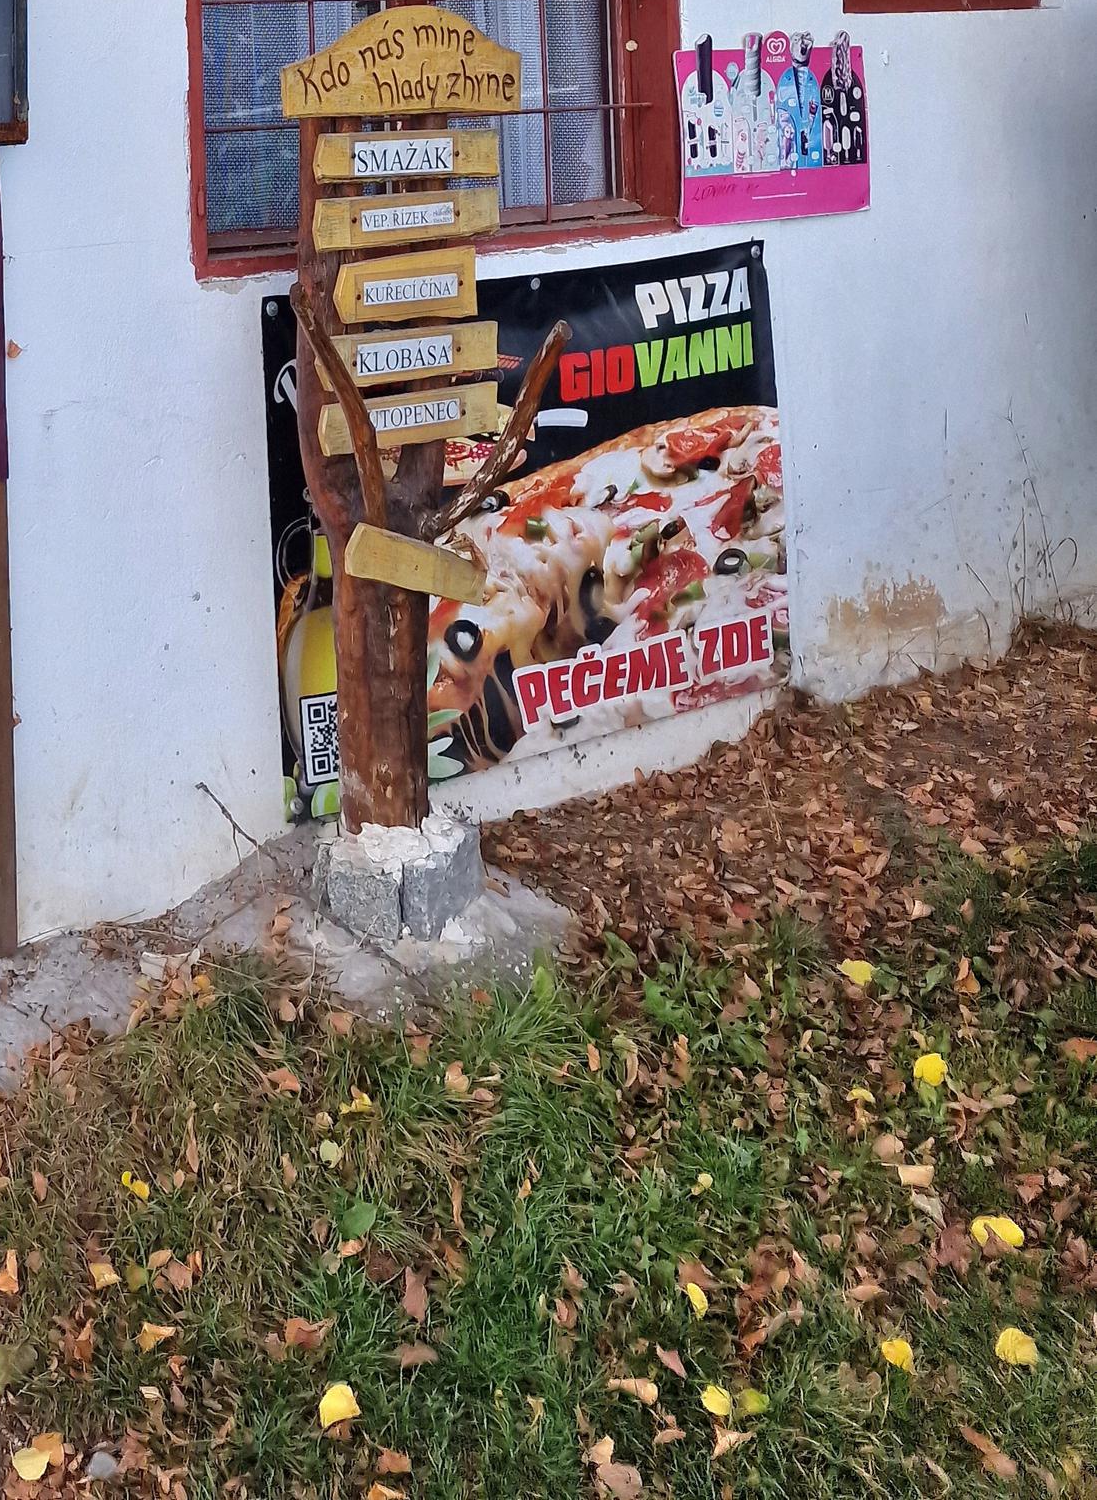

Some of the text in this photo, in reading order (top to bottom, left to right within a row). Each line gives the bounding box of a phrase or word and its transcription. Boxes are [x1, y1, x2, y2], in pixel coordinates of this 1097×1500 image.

[297, 54, 351, 106] Kdo
[358, 19, 405, 72] nás
[372, 60, 441, 108] hlady
[357, 140, 450, 173] SMAŽÁK
[363, 214, 390, 229] VEP.
[392, 208, 429, 227] ŘÍZEK
[365, 277, 452, 304] KUŘECÍ ČÍNA
[633, 267, 752, 329] PIZZA
[359, 339, 451, 374] KLOBÁSA
[558, 320, 754, 403] GIOVANNI
[515, 614, 771, 726] PEČEME ZDE
